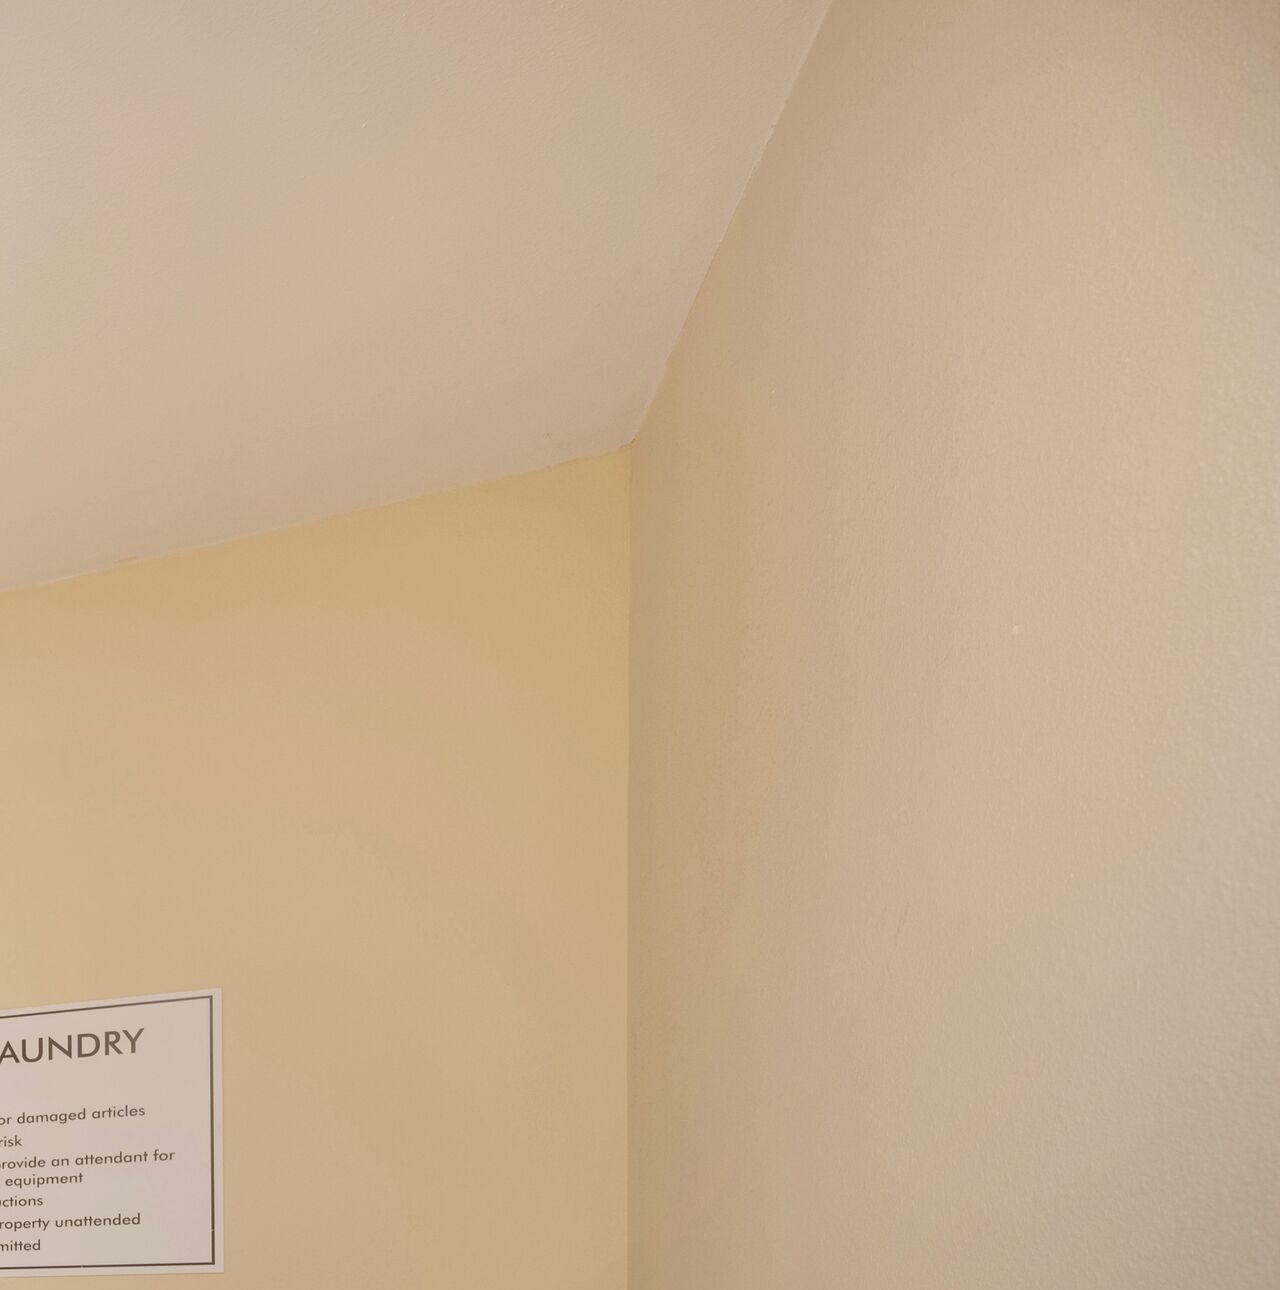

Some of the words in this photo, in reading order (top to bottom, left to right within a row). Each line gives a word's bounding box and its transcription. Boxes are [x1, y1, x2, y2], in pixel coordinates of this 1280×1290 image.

[16, 1107, 86, 1125] damaged
[91, 1104, 146, 1120] articles
[51, 1158, 70, 1167] an
[74, 1151, 148, 1166] attendant
[152, 1148, 176, 1162] for
[4, 1172, 84, 1189] equipment
[55, 1212, 141, 1228] unattended
